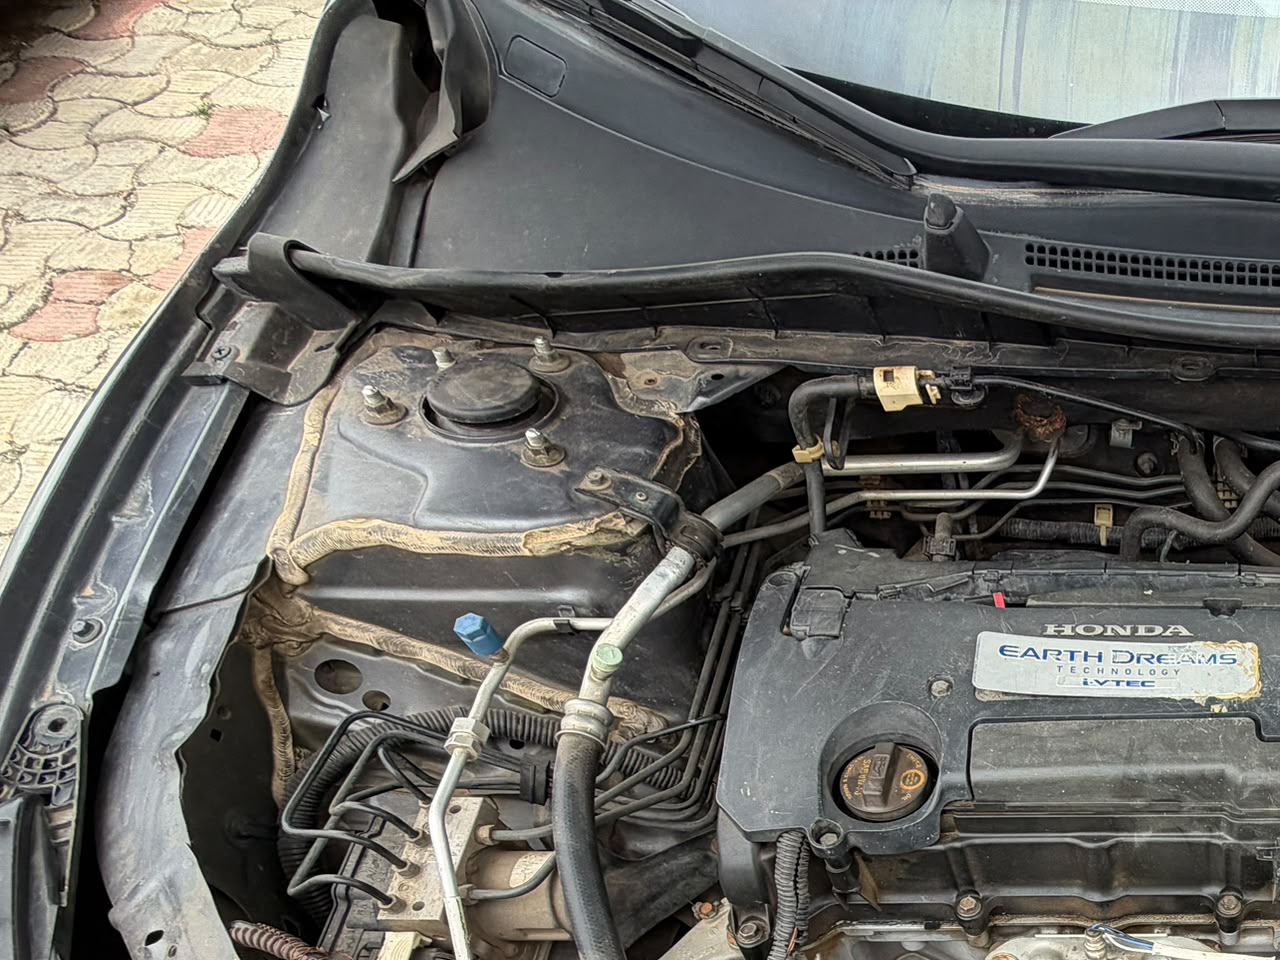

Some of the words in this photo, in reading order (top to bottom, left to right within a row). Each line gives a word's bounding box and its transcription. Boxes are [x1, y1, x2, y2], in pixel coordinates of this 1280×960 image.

[1042, 623, 1194, 637] HONDA
[999, 644, 1103, 664] EARTH
[1111, 649, 1238, 665] DREAMS
[1056, 665, 1181, 676] TECHNOLOGY
